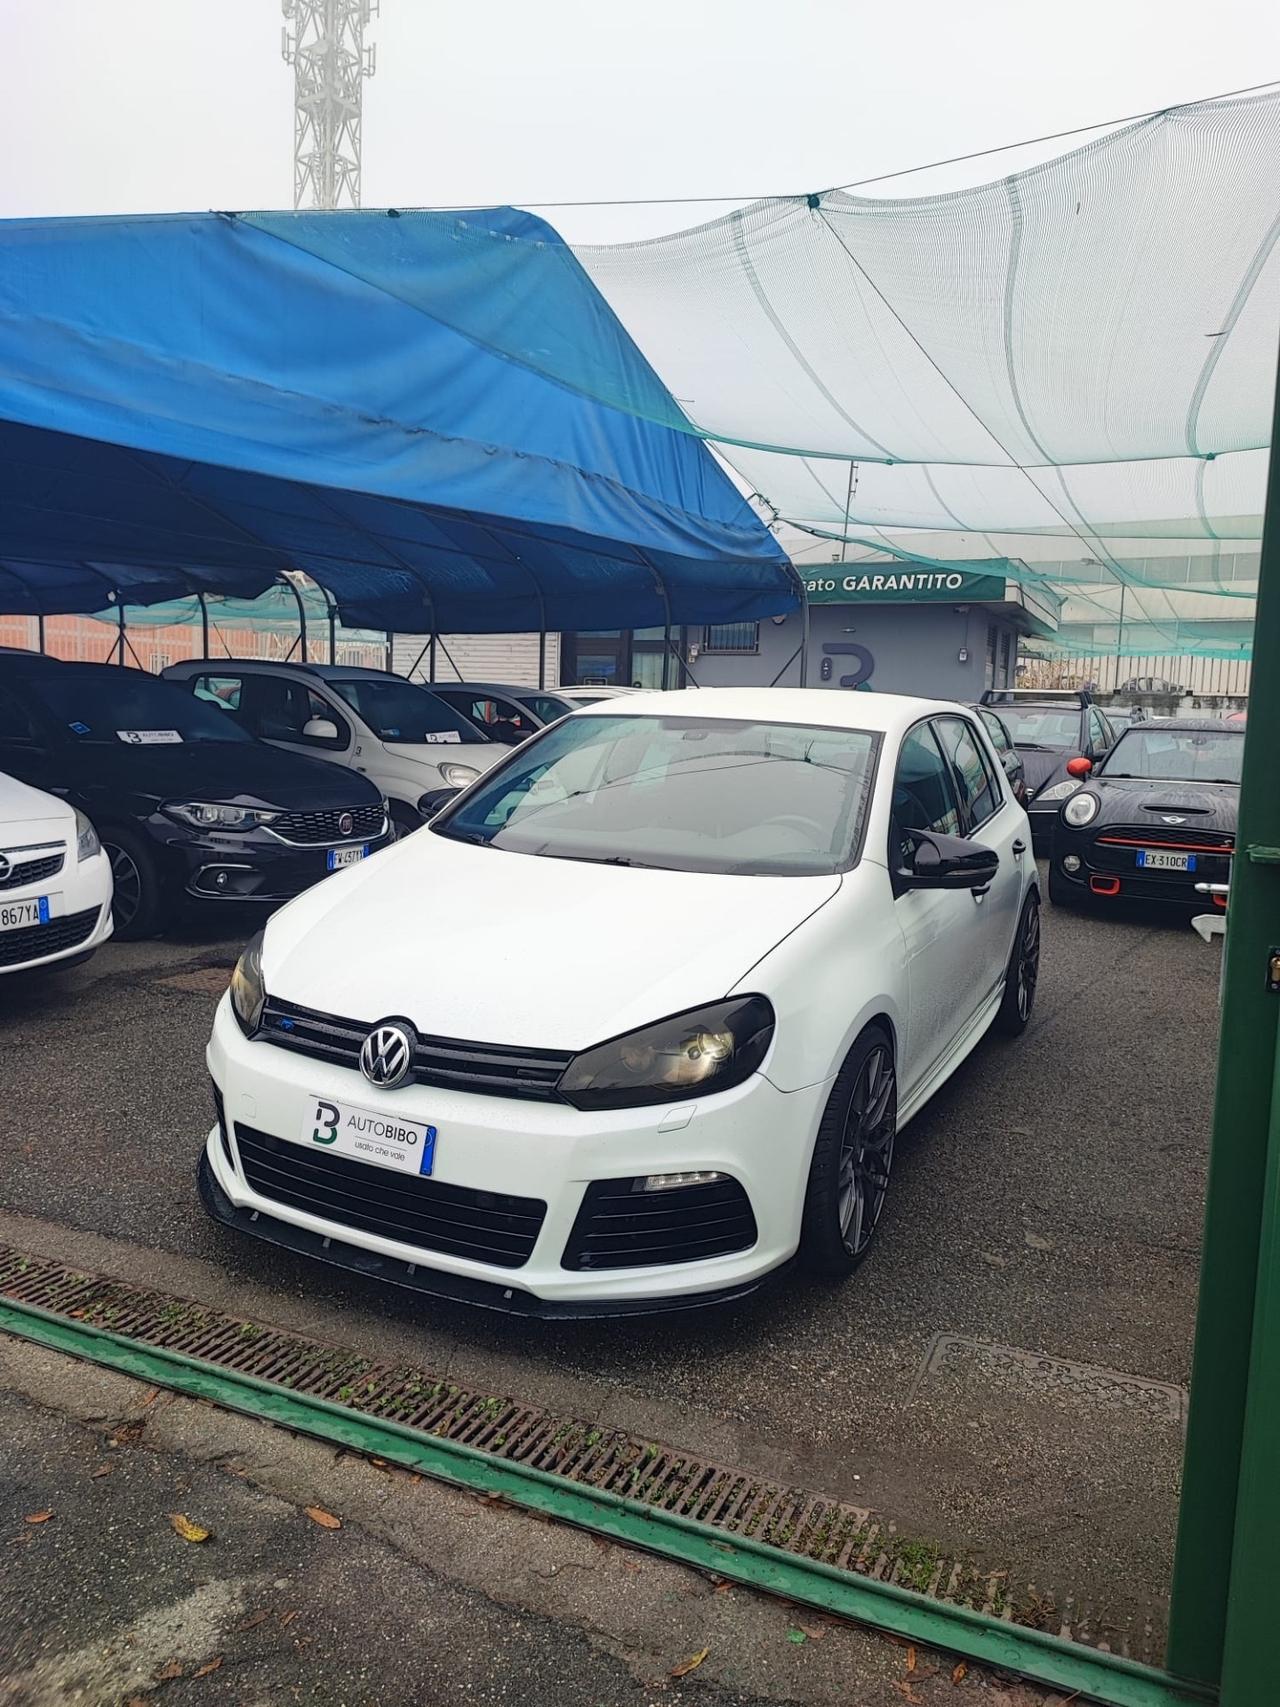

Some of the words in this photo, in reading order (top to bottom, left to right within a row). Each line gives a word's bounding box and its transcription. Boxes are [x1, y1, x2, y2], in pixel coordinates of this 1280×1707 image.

[842, 574, 962, 591] GARANTITO
[1, 904, 39, 926] 867YA
[347, 1115, 418, 1145] AUTOBIBO
[354, 1141, 374, 1152] usato
[374, 1147, 389, 1157] che
[390, 1151, 406, 1161] vale
